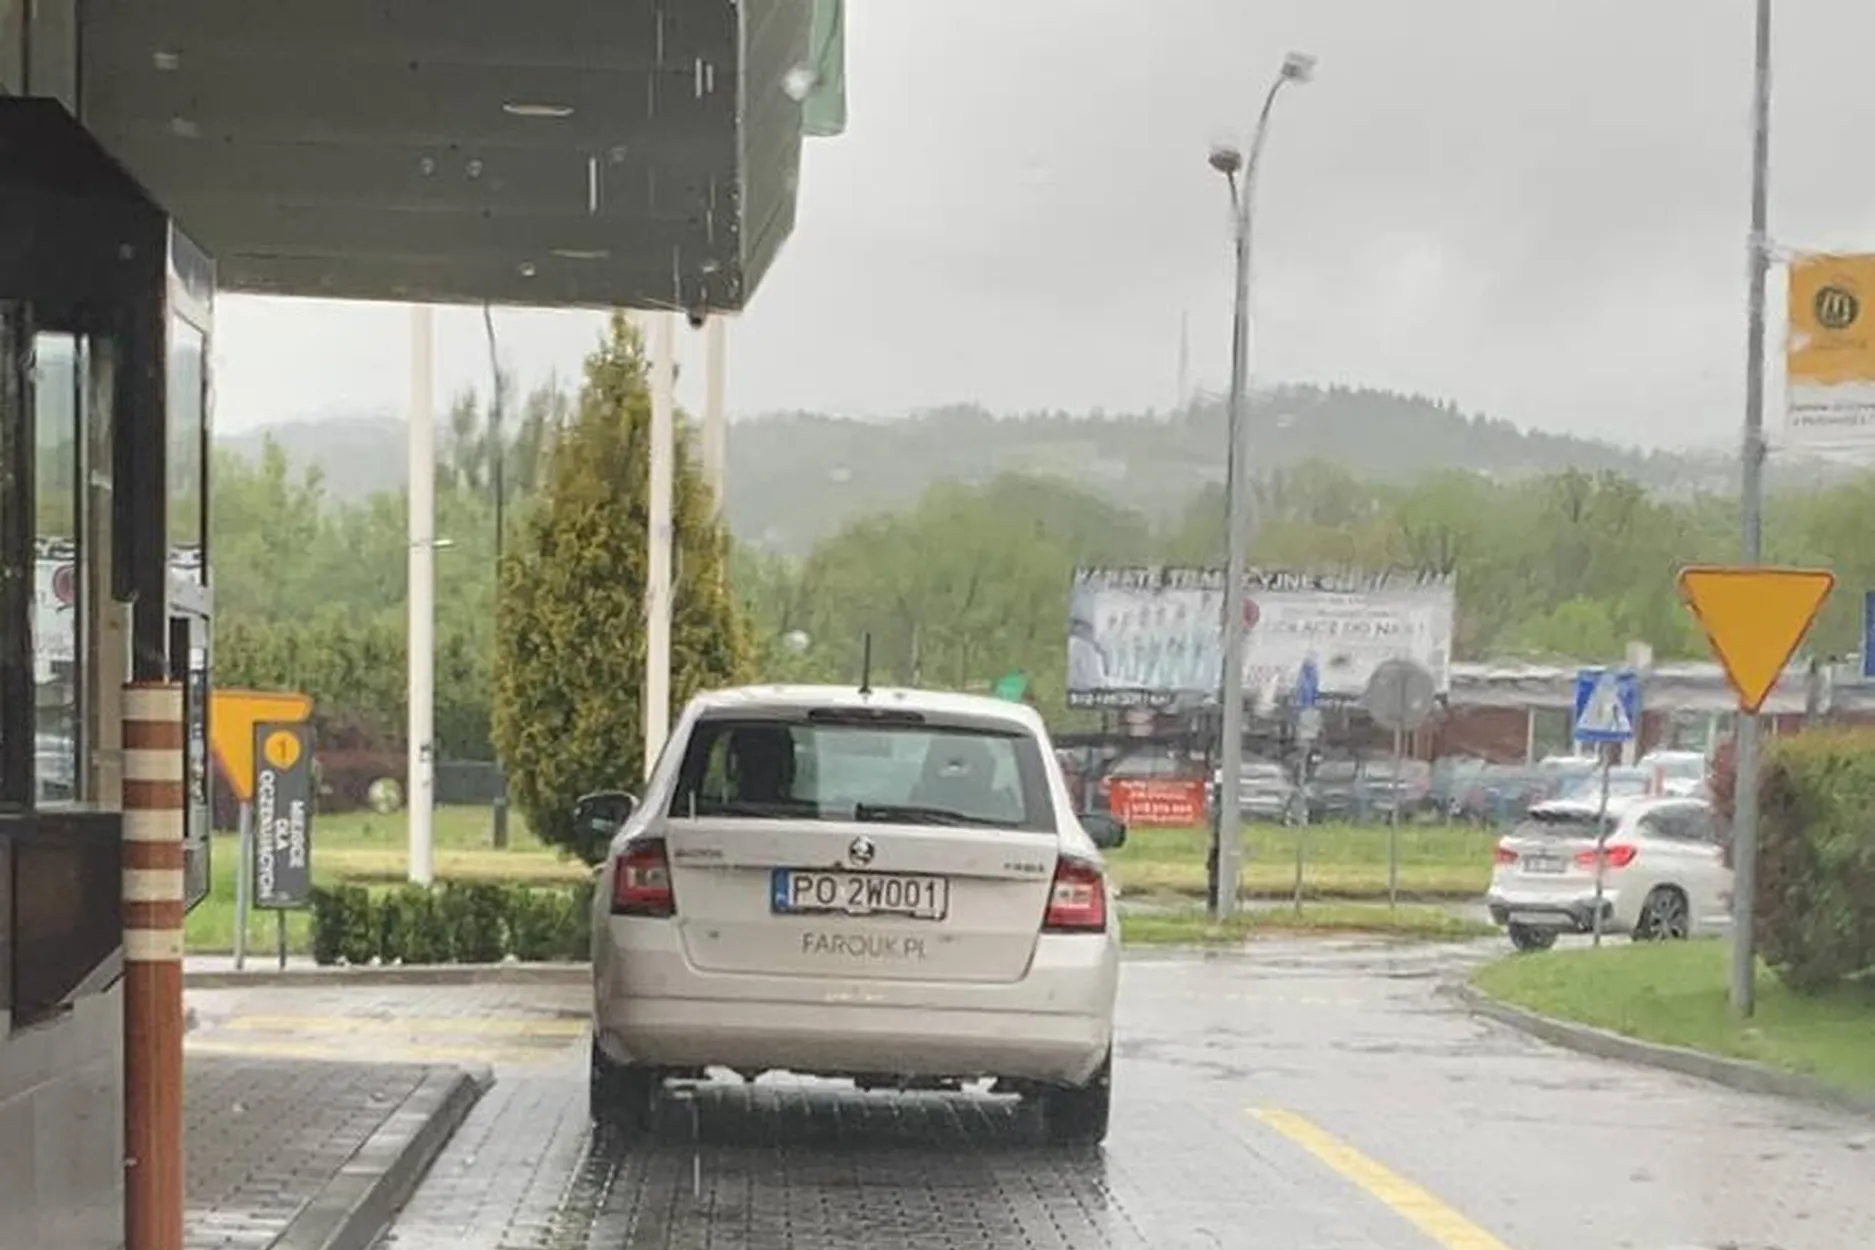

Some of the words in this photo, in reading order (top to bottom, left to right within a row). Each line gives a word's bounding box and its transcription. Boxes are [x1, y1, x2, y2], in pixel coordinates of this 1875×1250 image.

[275, 818, 288, 851] DLA
[289, 800, 305, 869] MIEJSCE
[793, 875, 837, 904] PO
[847, 877, 936, 908] 2W001
